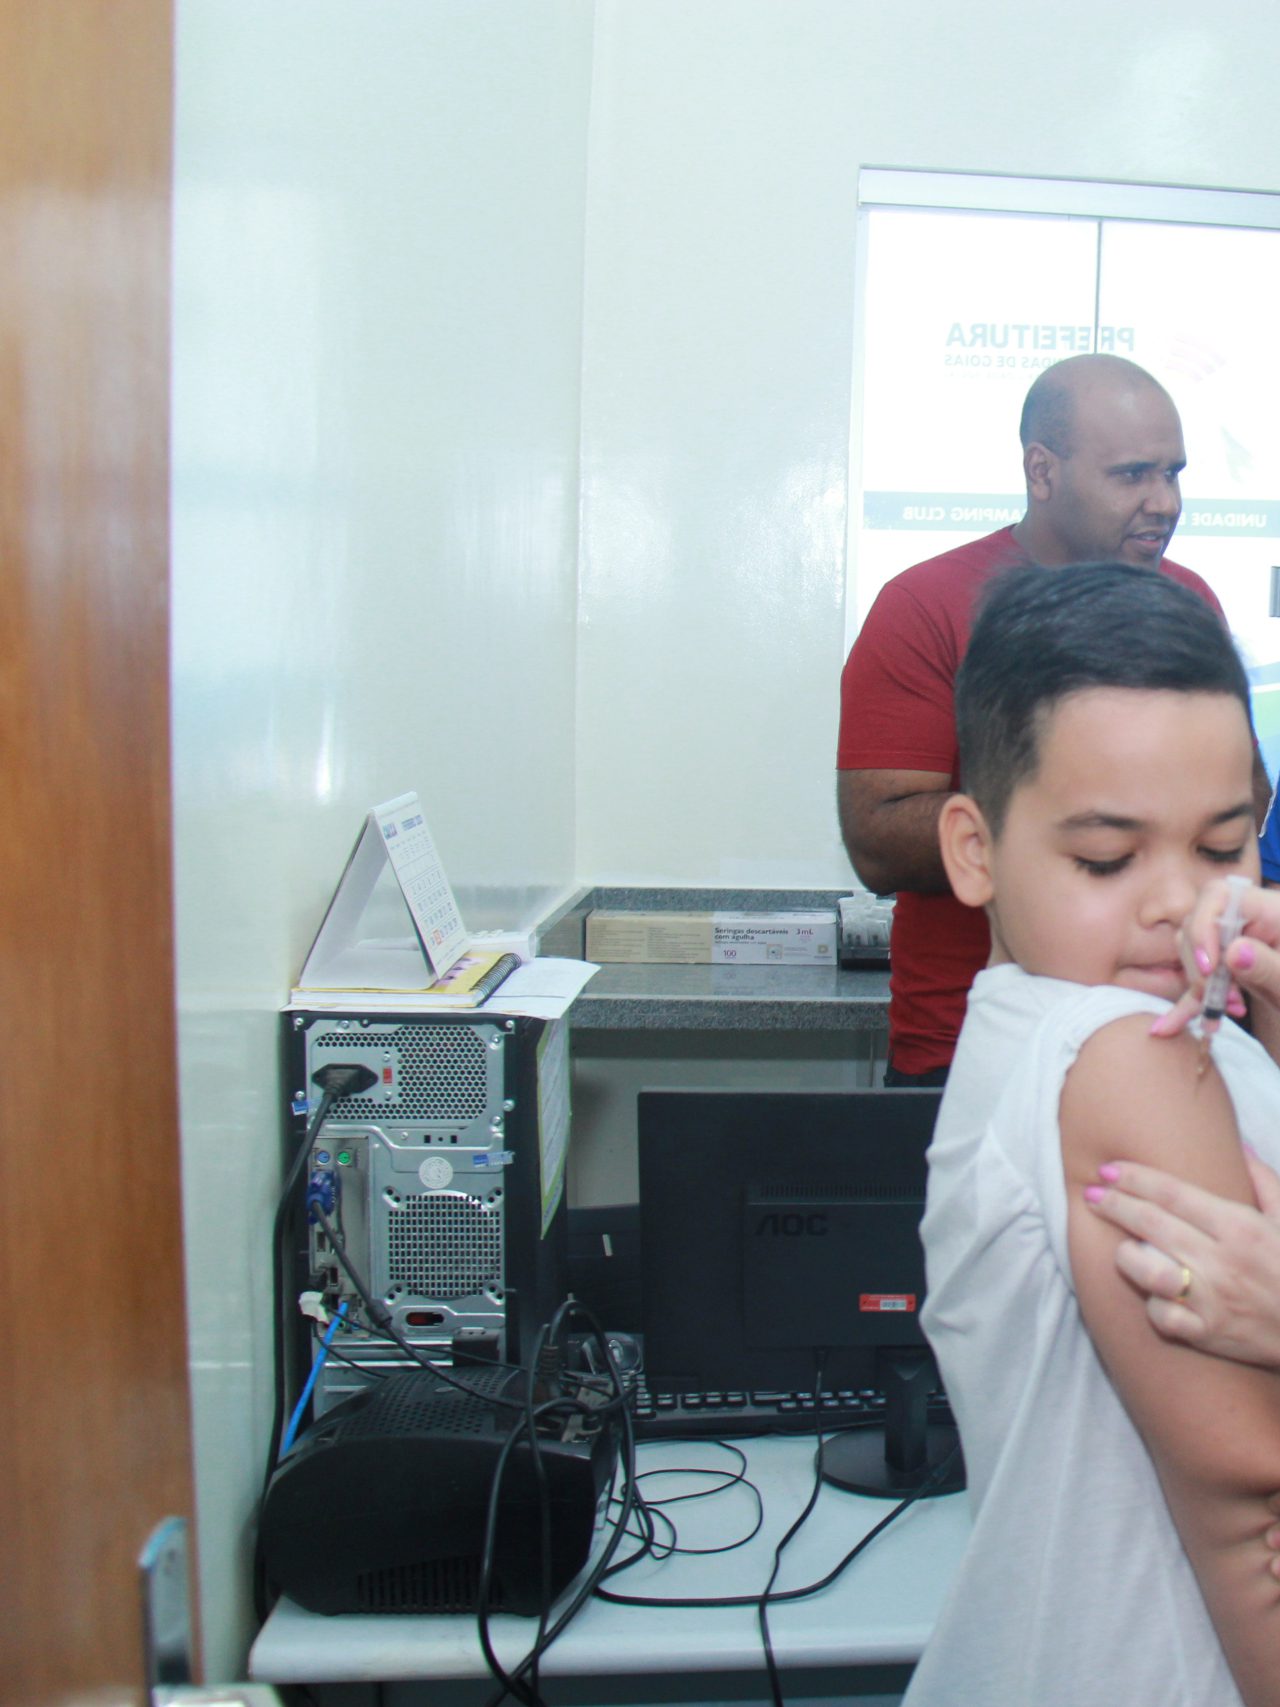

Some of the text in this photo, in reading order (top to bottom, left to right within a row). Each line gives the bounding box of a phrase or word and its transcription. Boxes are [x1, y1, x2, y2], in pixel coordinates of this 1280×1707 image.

[714, 927, 745, 936] Seringas
[731, 934, 755, 943] agulha
[723, 949, 737, 957] 100
[754, 1213, 830, 1237] AOC
